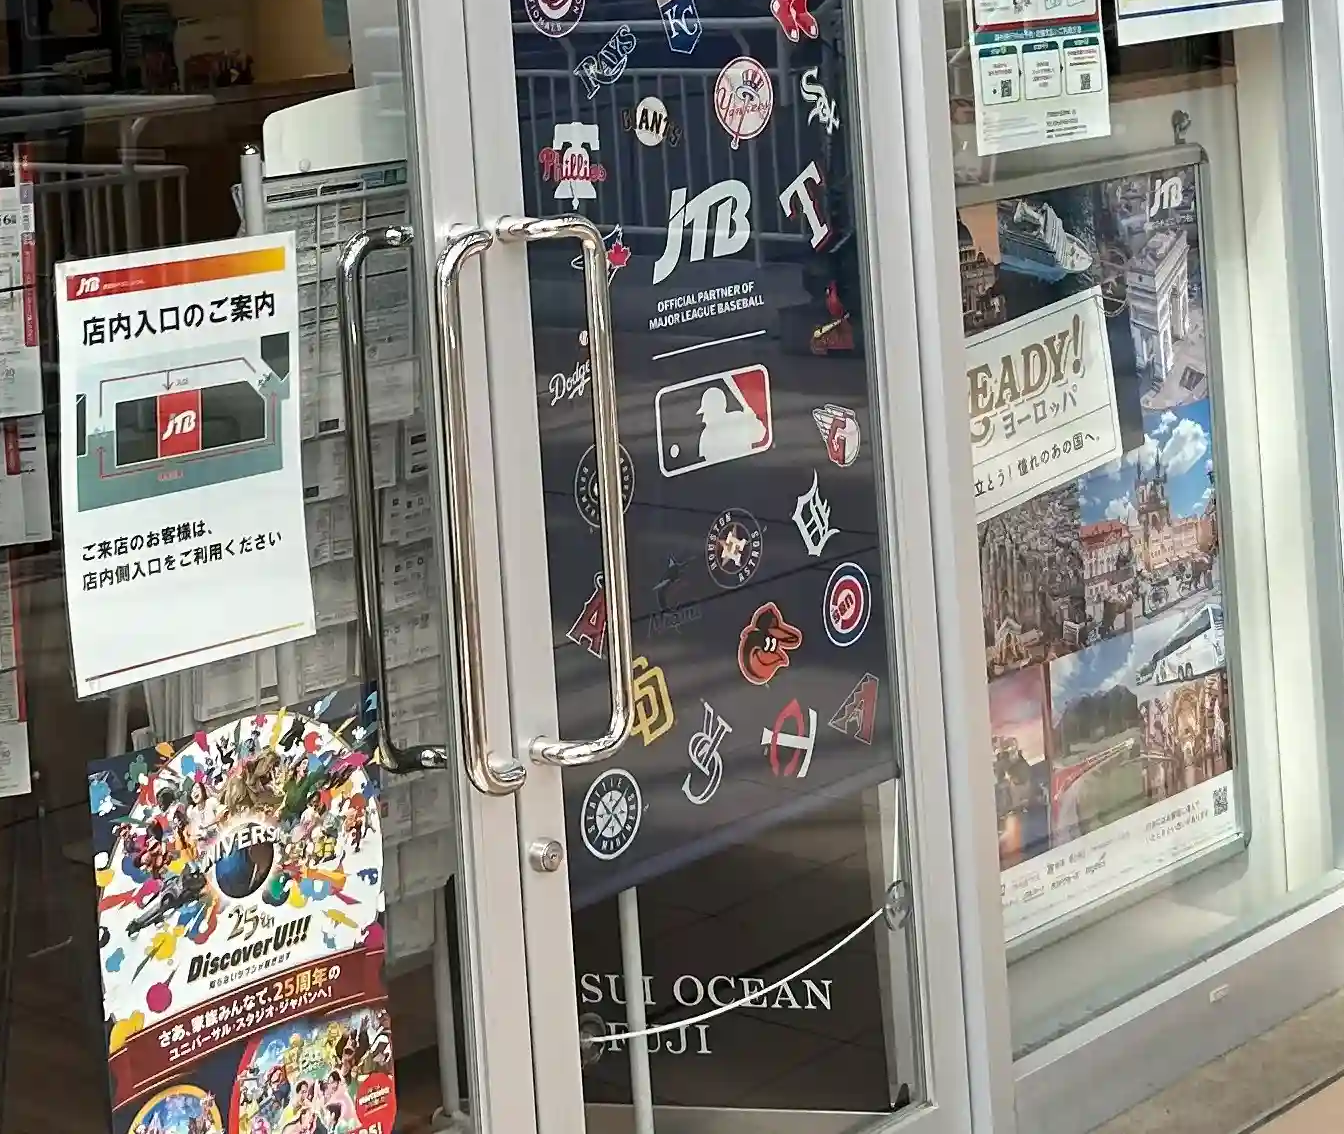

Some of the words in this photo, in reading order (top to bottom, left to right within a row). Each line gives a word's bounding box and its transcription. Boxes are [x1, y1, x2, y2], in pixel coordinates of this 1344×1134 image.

[664, 4, 699, 39] KC
[1150, 176, 1183, 217] JTB
[653, 179, 751, 285] JTB
[76, 277, 100, 296] JTB
[657, 292, 698, 313] OFFICIAL
[698, 284, 740, 303] PARTNER
[741, 281, 756, 294] OF
[83, 291, 275, 346] 店内入口のご案内
[648, 309, 681, 330] MAJOR
[681, 304, 717, 325] LEAGUE
[717, 294, 765, 314] BASEBALL
[549, 359, 591, 406] Dodge
[967, 313, 1086, 416] EADY!
[162, 410, 196, 441] JTB
[1003, 383, 1078, 439] ヨーロッパ
[82, 520, 213, 562] ご来店のお客様は、
[82, 531, 282, 591] 店内側入口をご利用ください
[673, 975, 833, 1010] OCEAN
